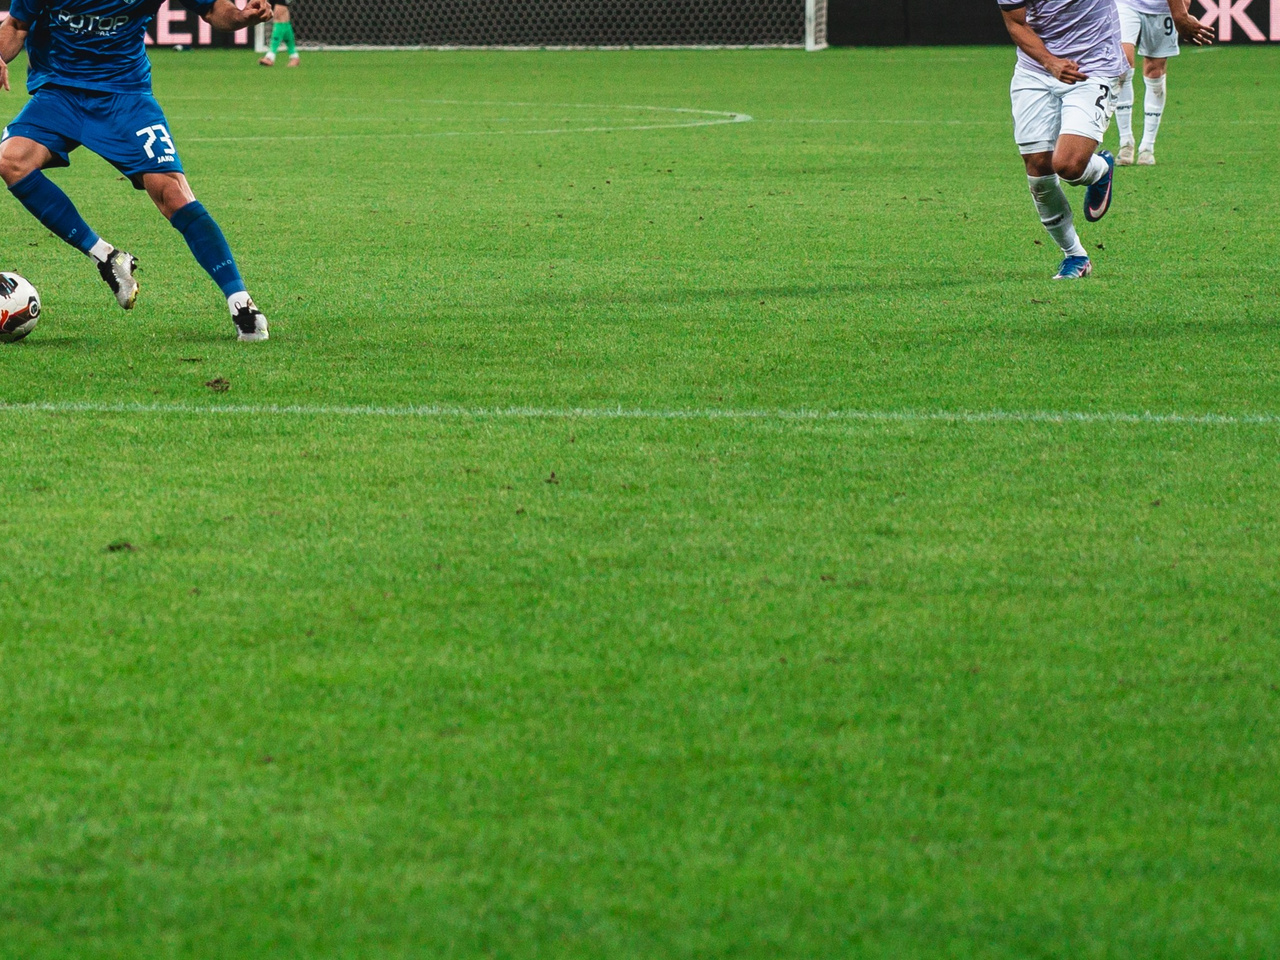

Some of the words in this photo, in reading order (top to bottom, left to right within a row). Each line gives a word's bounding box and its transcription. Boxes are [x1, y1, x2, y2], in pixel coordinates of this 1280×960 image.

[1164, 16, 1173, 36] 9
[135, 124, 176, 159] 73
[212, 259, 233, 272] JAKO
